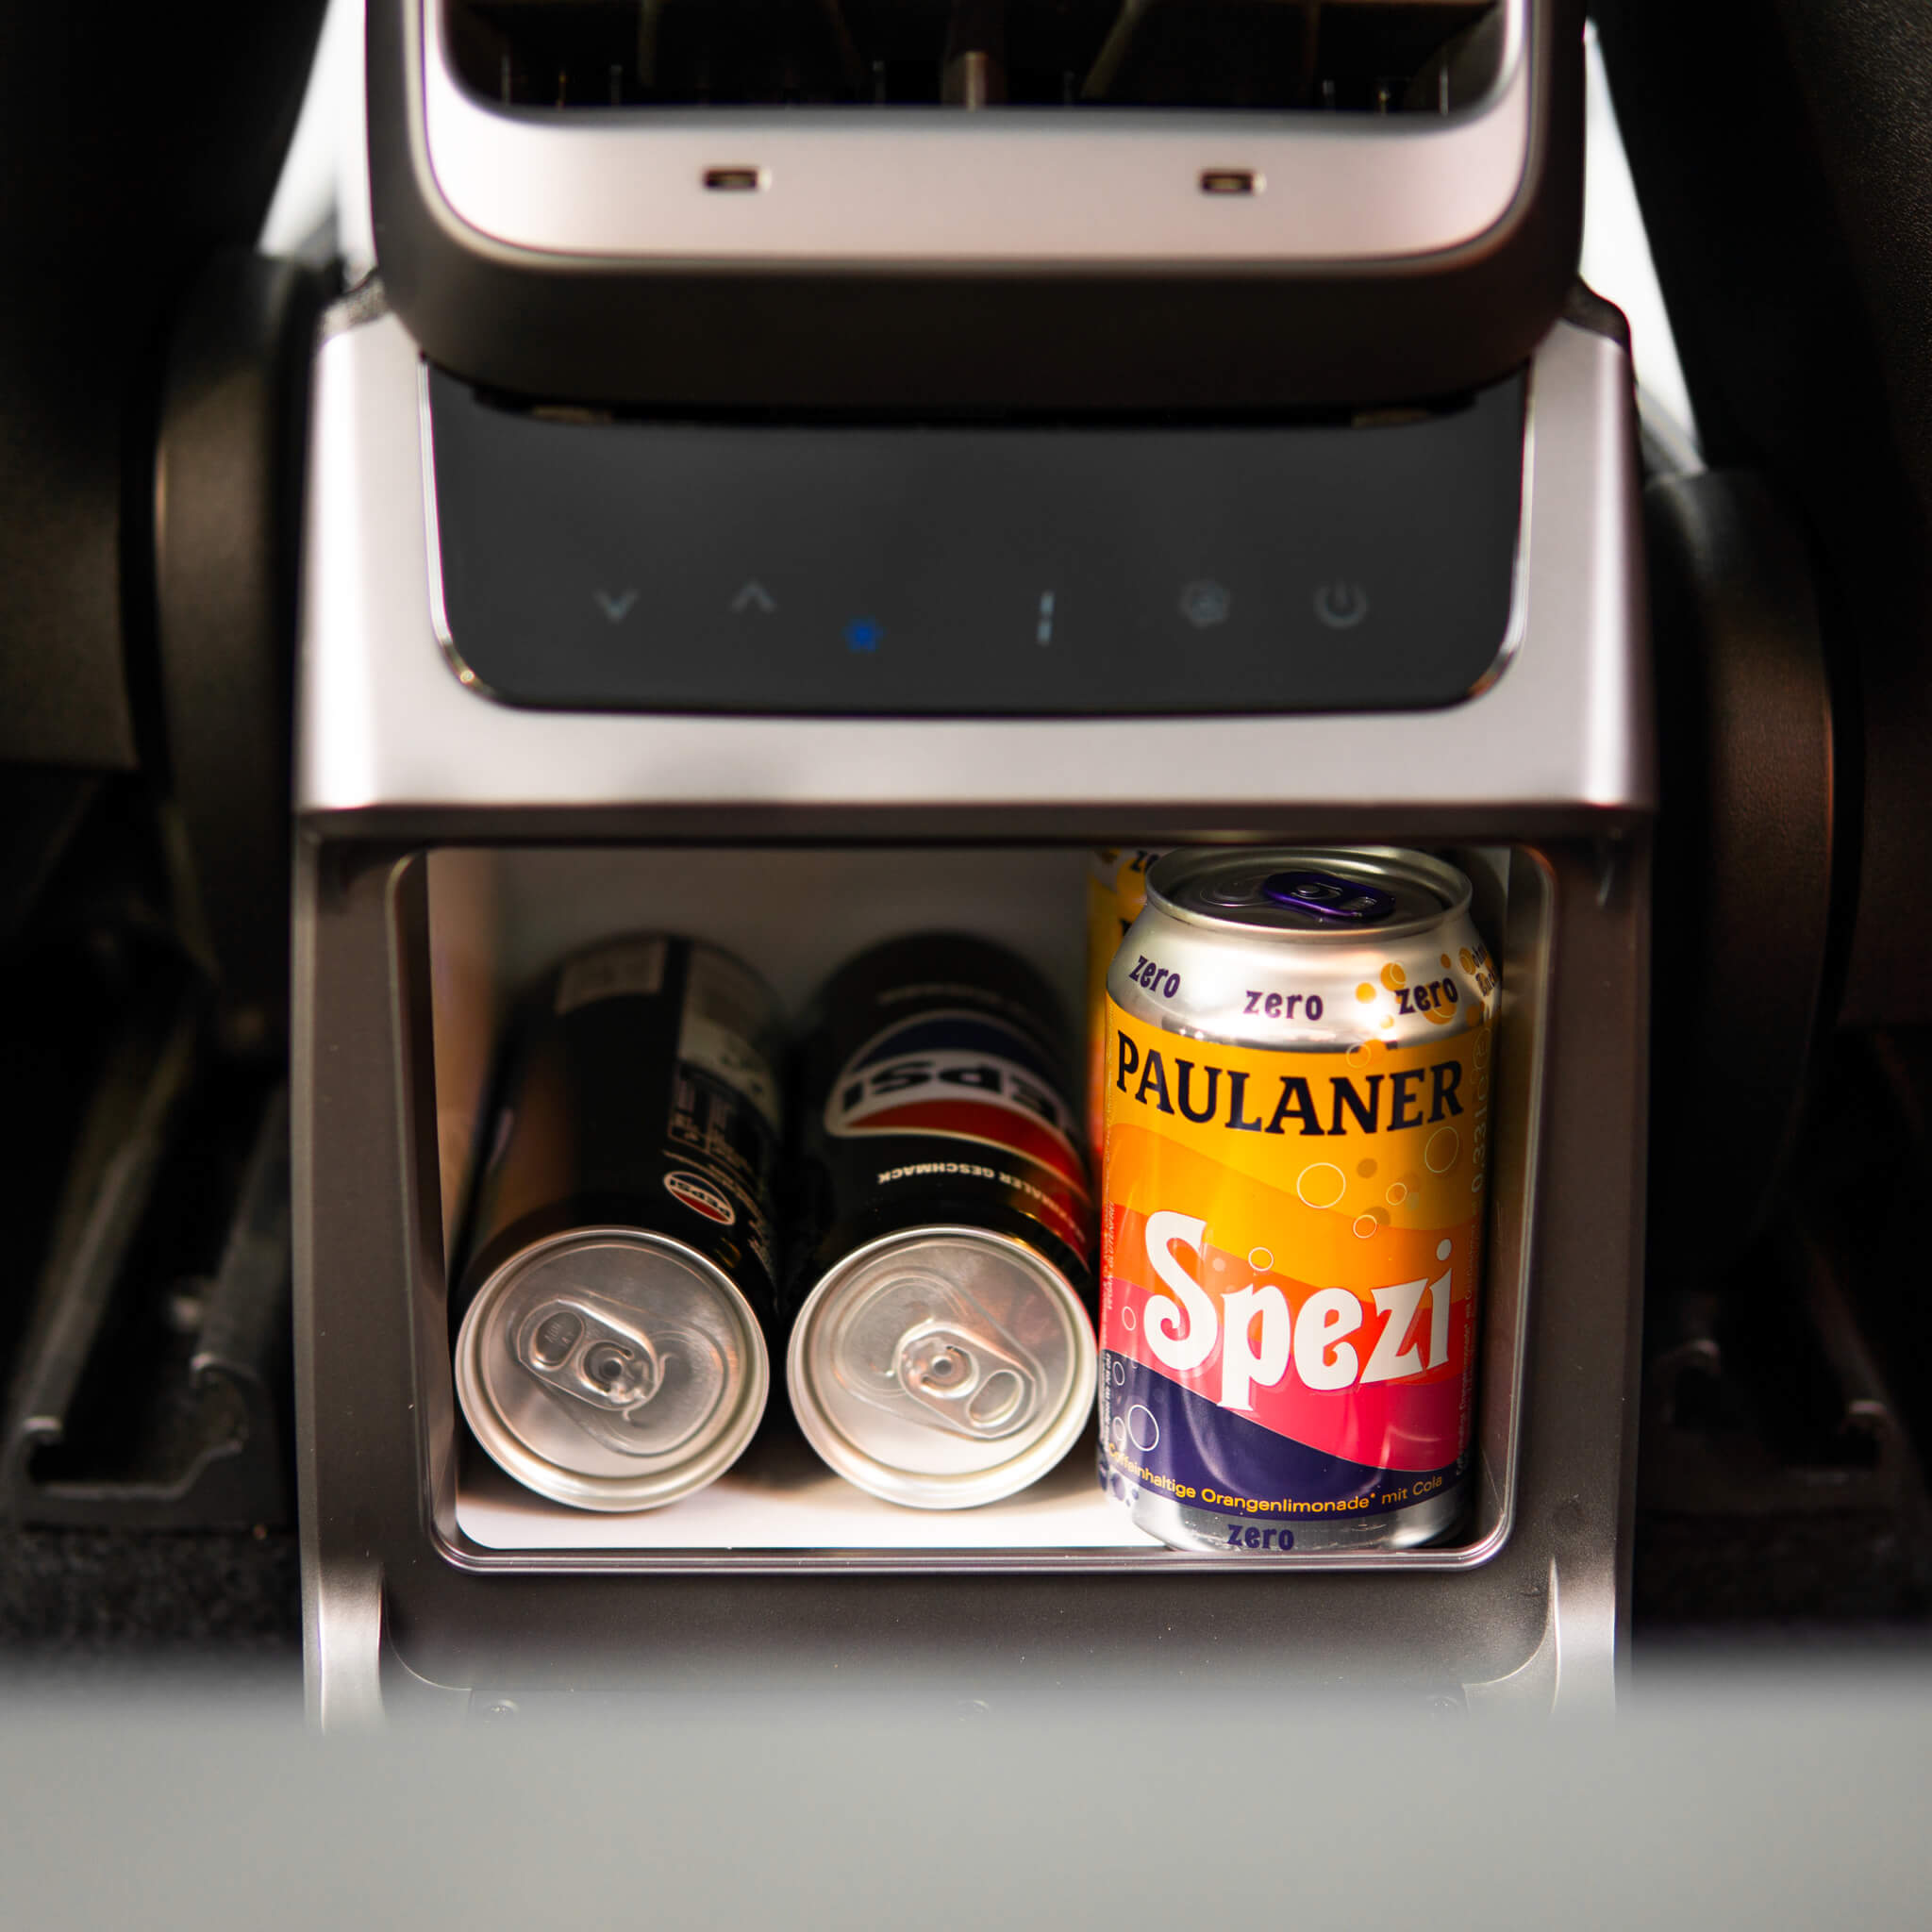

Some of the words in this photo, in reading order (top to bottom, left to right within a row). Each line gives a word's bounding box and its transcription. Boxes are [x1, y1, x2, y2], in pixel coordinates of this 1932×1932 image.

[1128, 955, 1181, 999] zero
[1394, 977, 1459, 1016] zero
[1243, 990, 1324, 1022] zero
[841, 1059, 1066, 1129] EPSI
[1116, 1029, 1465, 1136] PAULANER
[878, 1162, 995, 1185] GESCHMACK
[1143, 1210, 1453, 1411] Spezi
[1381, 1488, 1408, 1505] mit
[1412, 1475, 1442, 1495] Cola
[1226, 1524, 1294, 1551] zero
